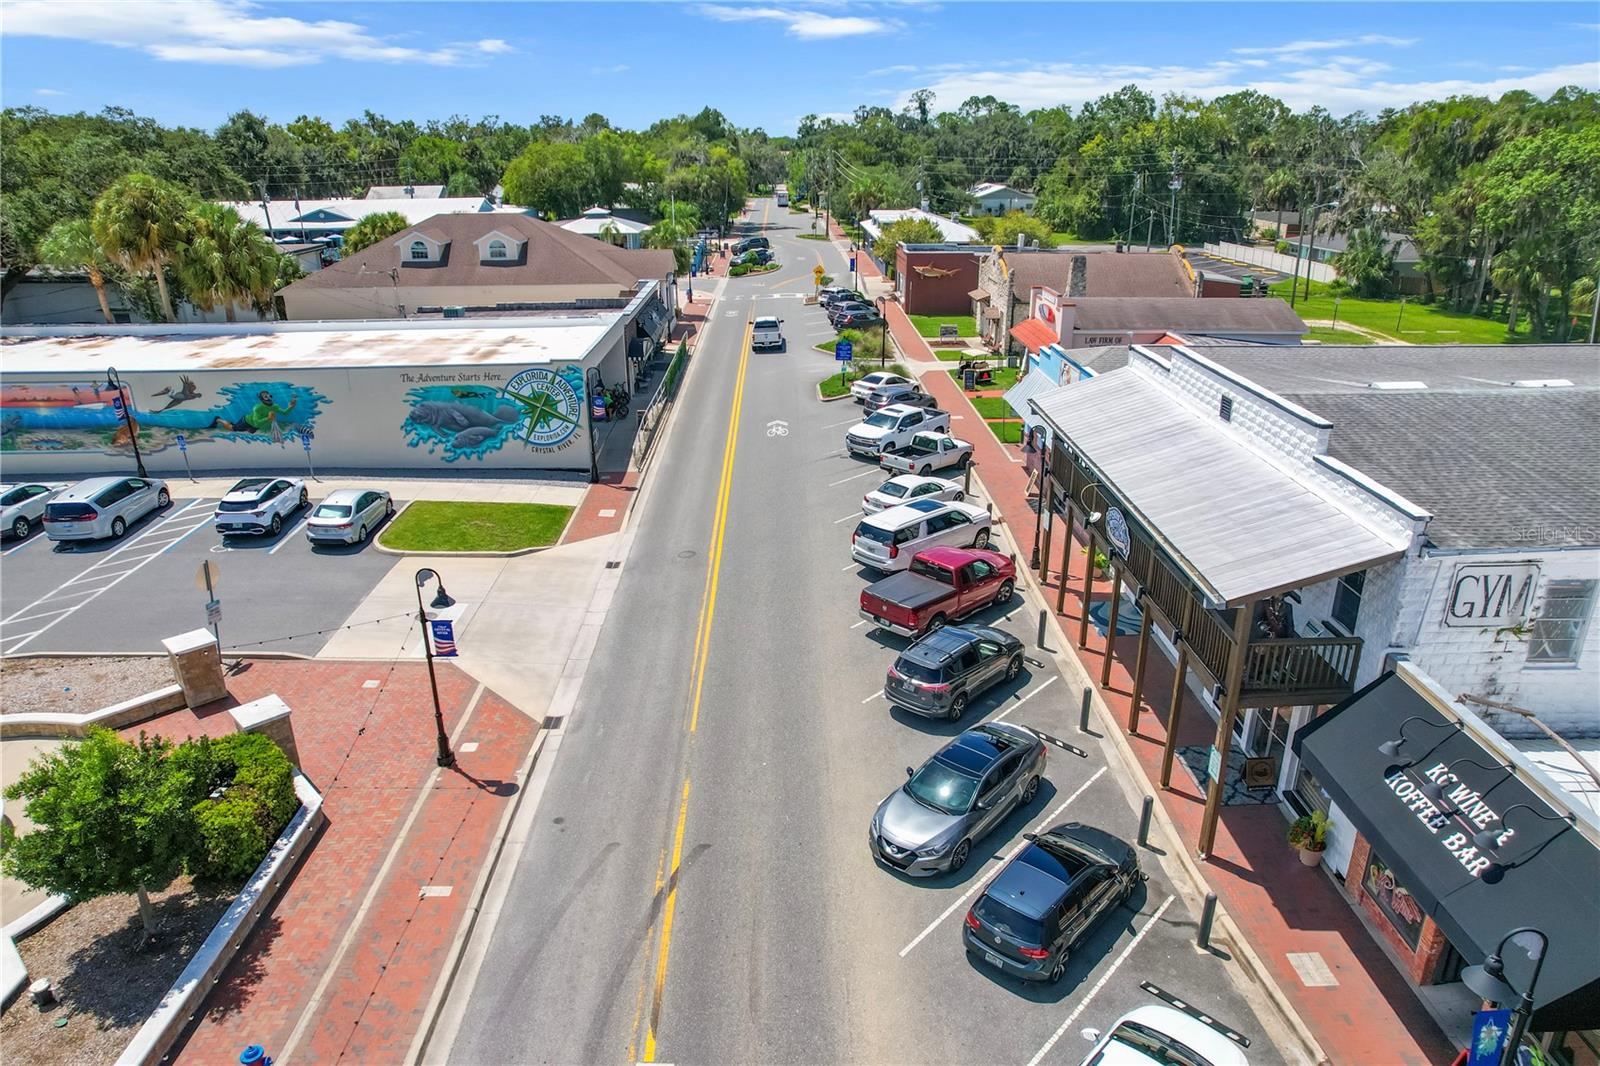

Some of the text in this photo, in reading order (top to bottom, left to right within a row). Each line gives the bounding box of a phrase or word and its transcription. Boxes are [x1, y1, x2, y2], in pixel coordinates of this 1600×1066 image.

[400, 373, 414, 383] The
[416, 372, 456, 383] Adventure
[457, 371, 480, 382] Starts
[510, 371, 578, 418] EXPLORIDA ADVENTURE
[536, 383, 561, 399] CENTER
[531, 446, 555, 454] CRYSTAL
[1450, 574, 1533, 618] GYM
[1384, 771, 1491, 878] KOFFEE BAR
[1447, 782, 1500, 831] WINE
